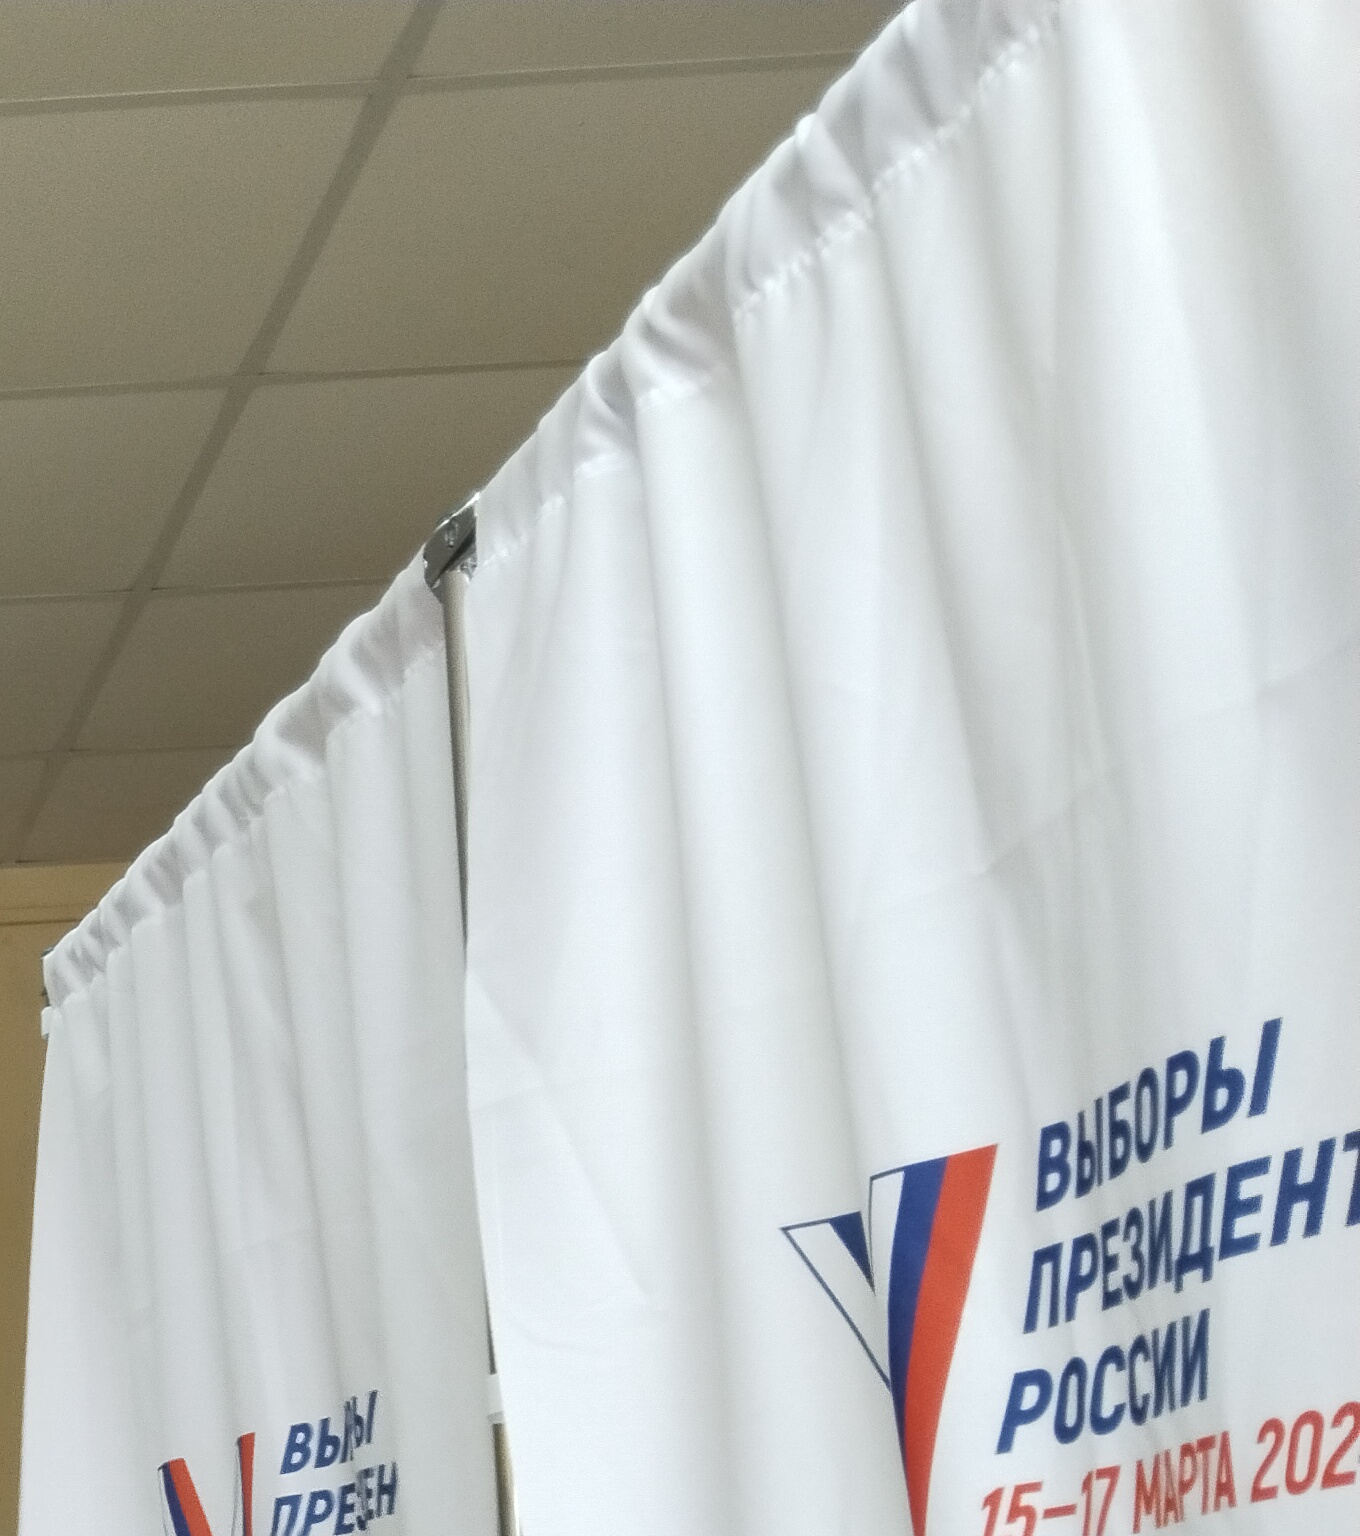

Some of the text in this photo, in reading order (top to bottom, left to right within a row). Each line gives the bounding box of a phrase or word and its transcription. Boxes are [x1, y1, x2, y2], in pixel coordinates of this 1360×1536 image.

[1035, 1016, 1283, 1212] ВЫБОРЫ
[995, 1308, 1211, 1455] РОССИИ
[1131, 1429, 1237, 1535] МАРТА
[1250, 1401, 1360, 1504] 202
